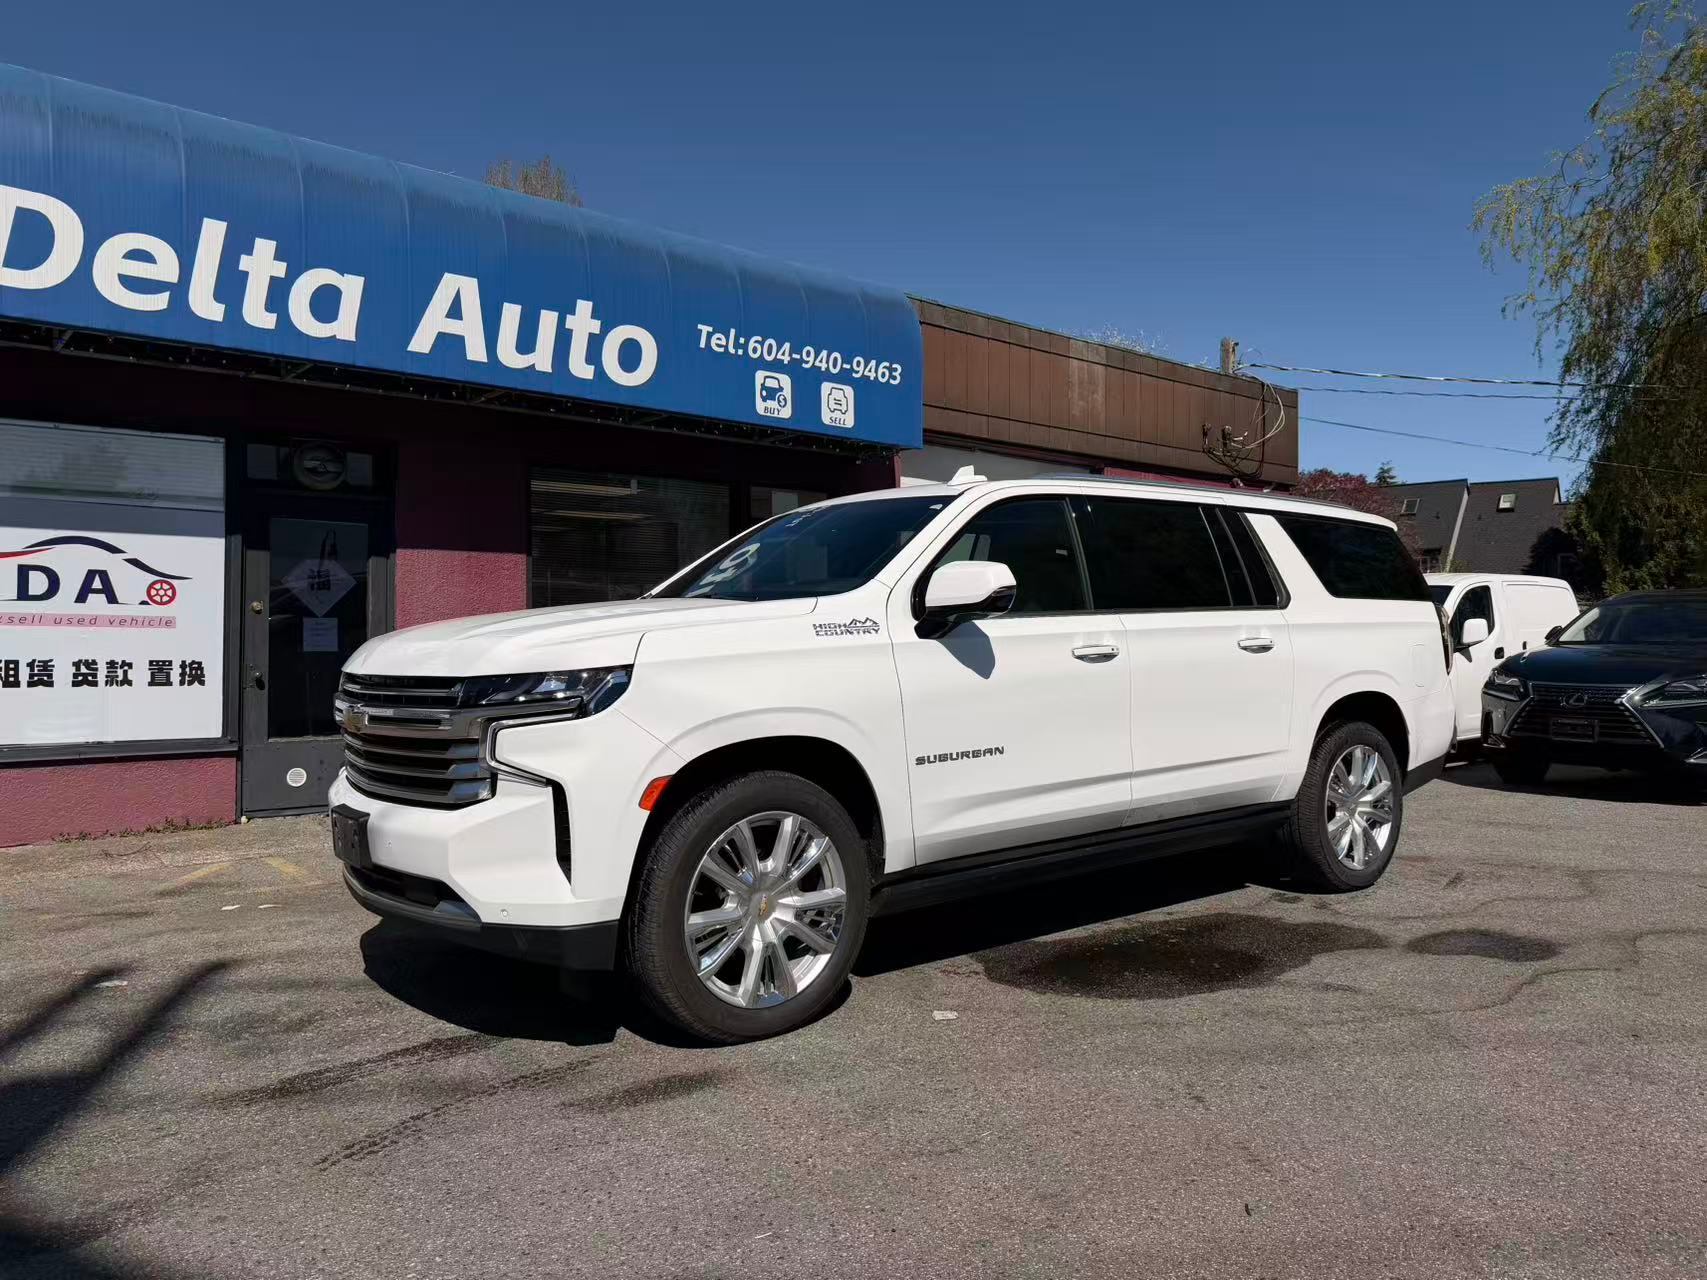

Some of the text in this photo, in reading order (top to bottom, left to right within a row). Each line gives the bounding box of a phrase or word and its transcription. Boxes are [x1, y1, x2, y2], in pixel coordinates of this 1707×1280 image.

[0, 184, 658, 387] Delta Auto
[763, 405, 782, 416] BUY
[828, 416, 847, 426] SELL
[0, 614, 174, 628] sell used vehicle
[812, 622, 848, 631] HIGH
[815, 627, 881, 637] COUNTRY
[0, 658, 206, 689] 租赁 贷款 置换
[915, 746, 1005, 766] SUBURBAN
